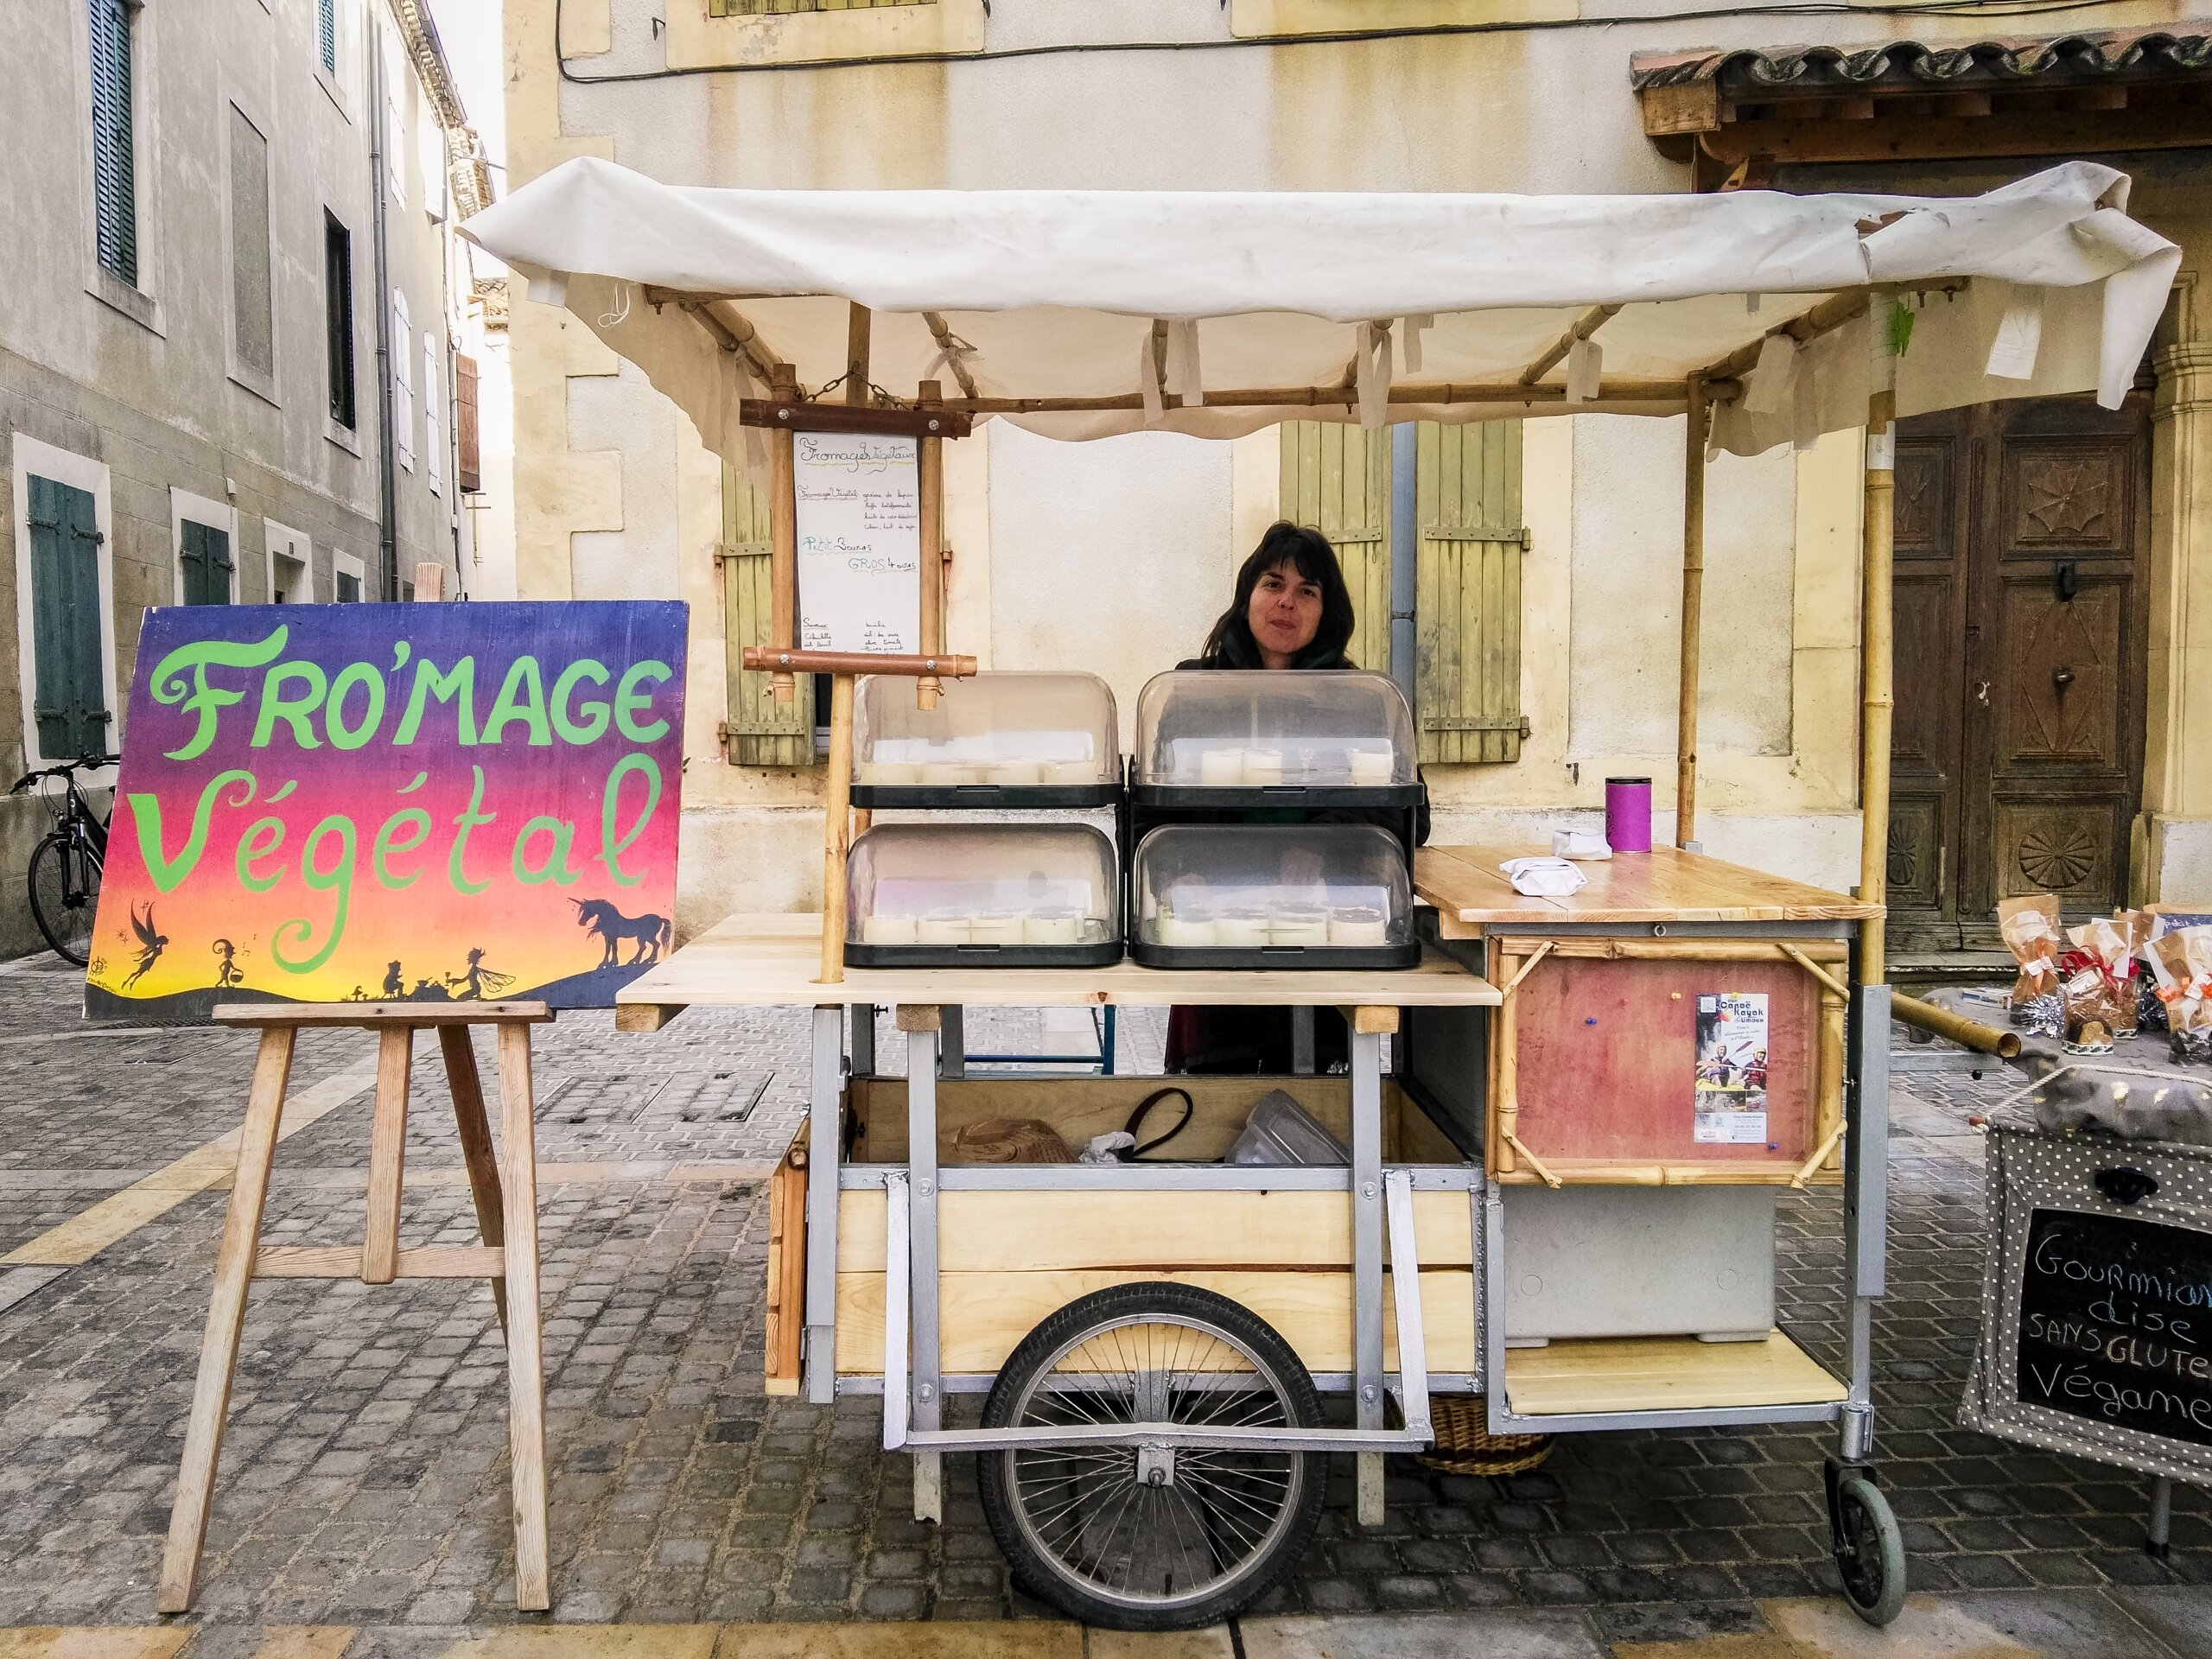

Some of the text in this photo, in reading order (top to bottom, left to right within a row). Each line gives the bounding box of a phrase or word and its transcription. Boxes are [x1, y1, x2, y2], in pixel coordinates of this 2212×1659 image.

[849, 558, 885, 574] GROS
[887, 557, 895, 569] 4
[149, 623, 673, 760] FRO'MAGE
[127, 752, 663, 974] Végétal
[1720, 1001, 1751, 1009] Canoë
[1734, 1008, 1764, 1018] Kayak
[2030, 1313, 2101, 1351] SANS
[2088, 1290, 2198, 1344] dise
